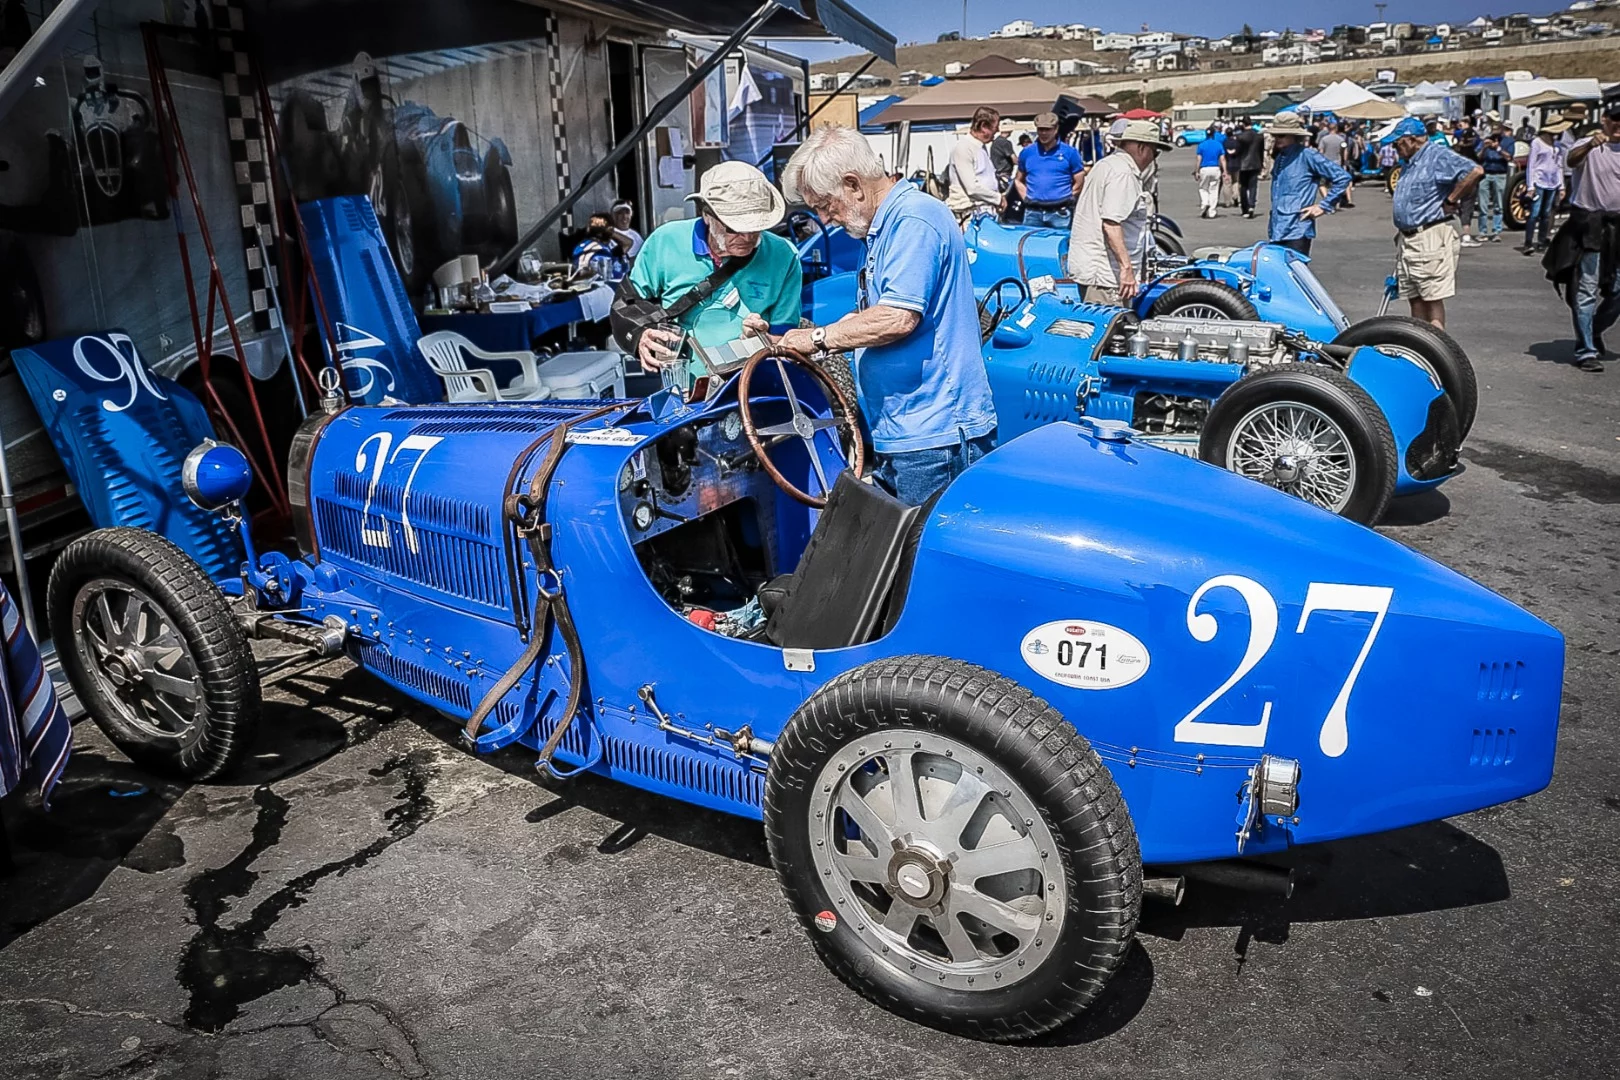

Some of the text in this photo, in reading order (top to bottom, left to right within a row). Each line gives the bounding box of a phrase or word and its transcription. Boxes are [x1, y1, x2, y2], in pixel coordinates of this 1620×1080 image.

[355, 431, 446, 555] 27
[1057, 640, 1107, 670] 071
[1173, 573, 1395, 758] 27
[784, 706, 938, 791] BLOCKLEY
